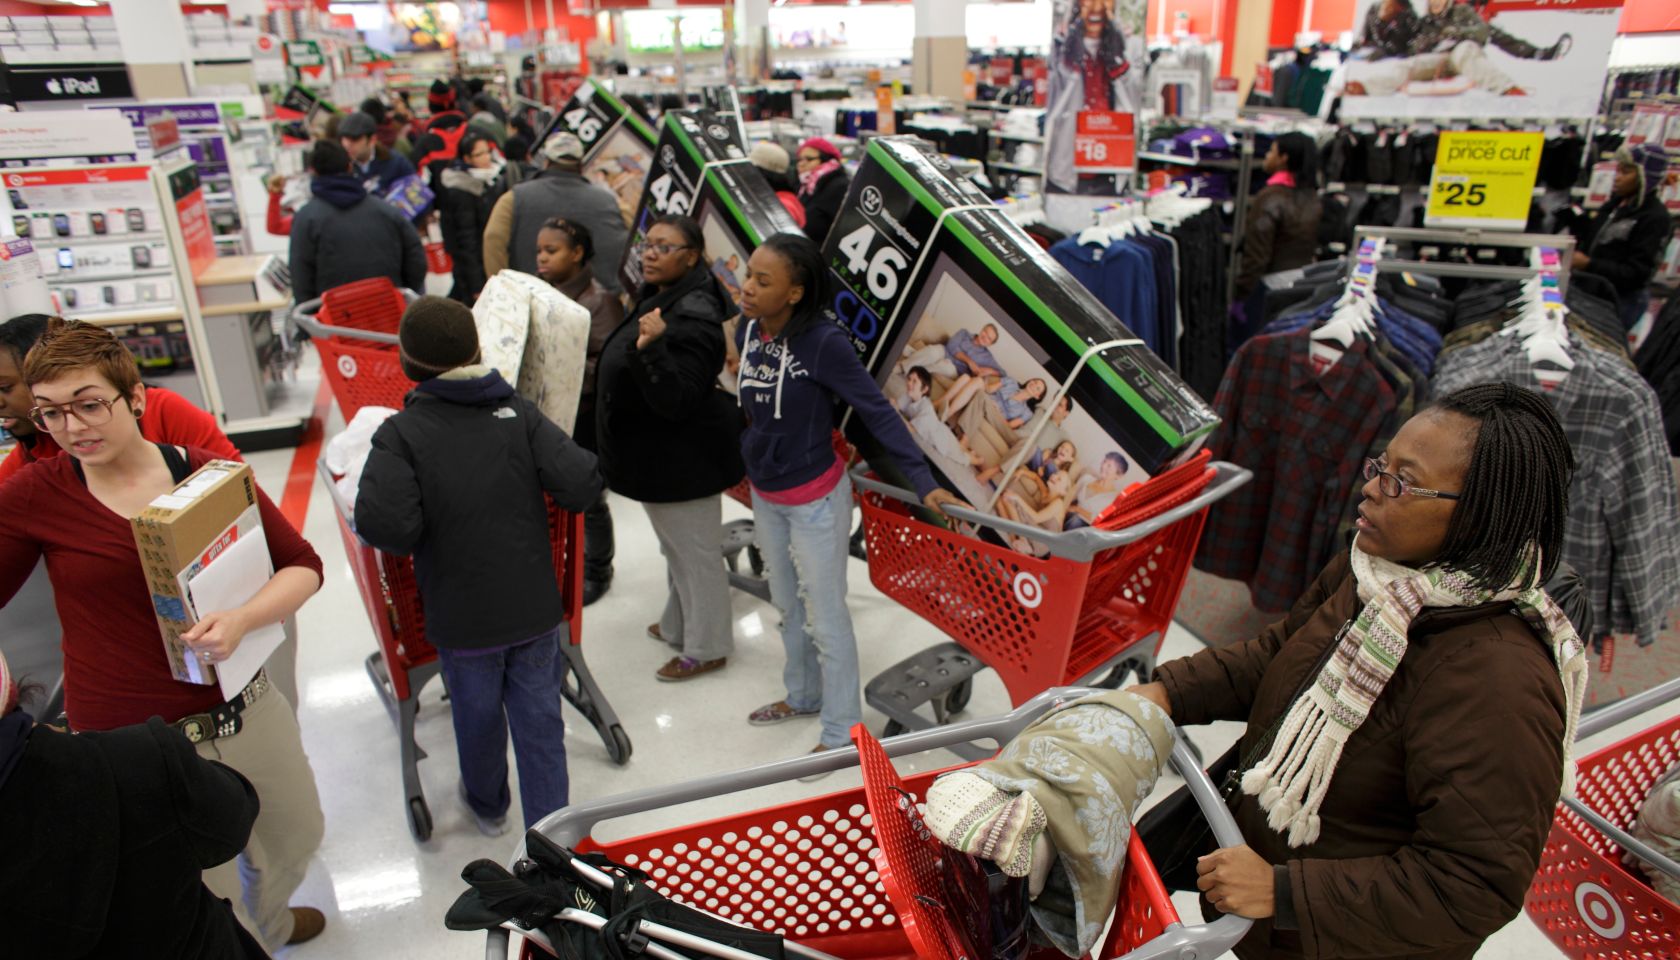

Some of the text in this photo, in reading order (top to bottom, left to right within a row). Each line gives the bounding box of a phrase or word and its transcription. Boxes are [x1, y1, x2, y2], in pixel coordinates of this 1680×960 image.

[62, 76, 100, 94] iPad
[564, 107, 602, 142] 46
[1447, 145, 1531, 164] price cut
[1437, 183, 1486, 206] $25
[838, 224, 907, 300] 46
[834, 290, 877, 341] CD
[755, 393, 771, 404] NY
